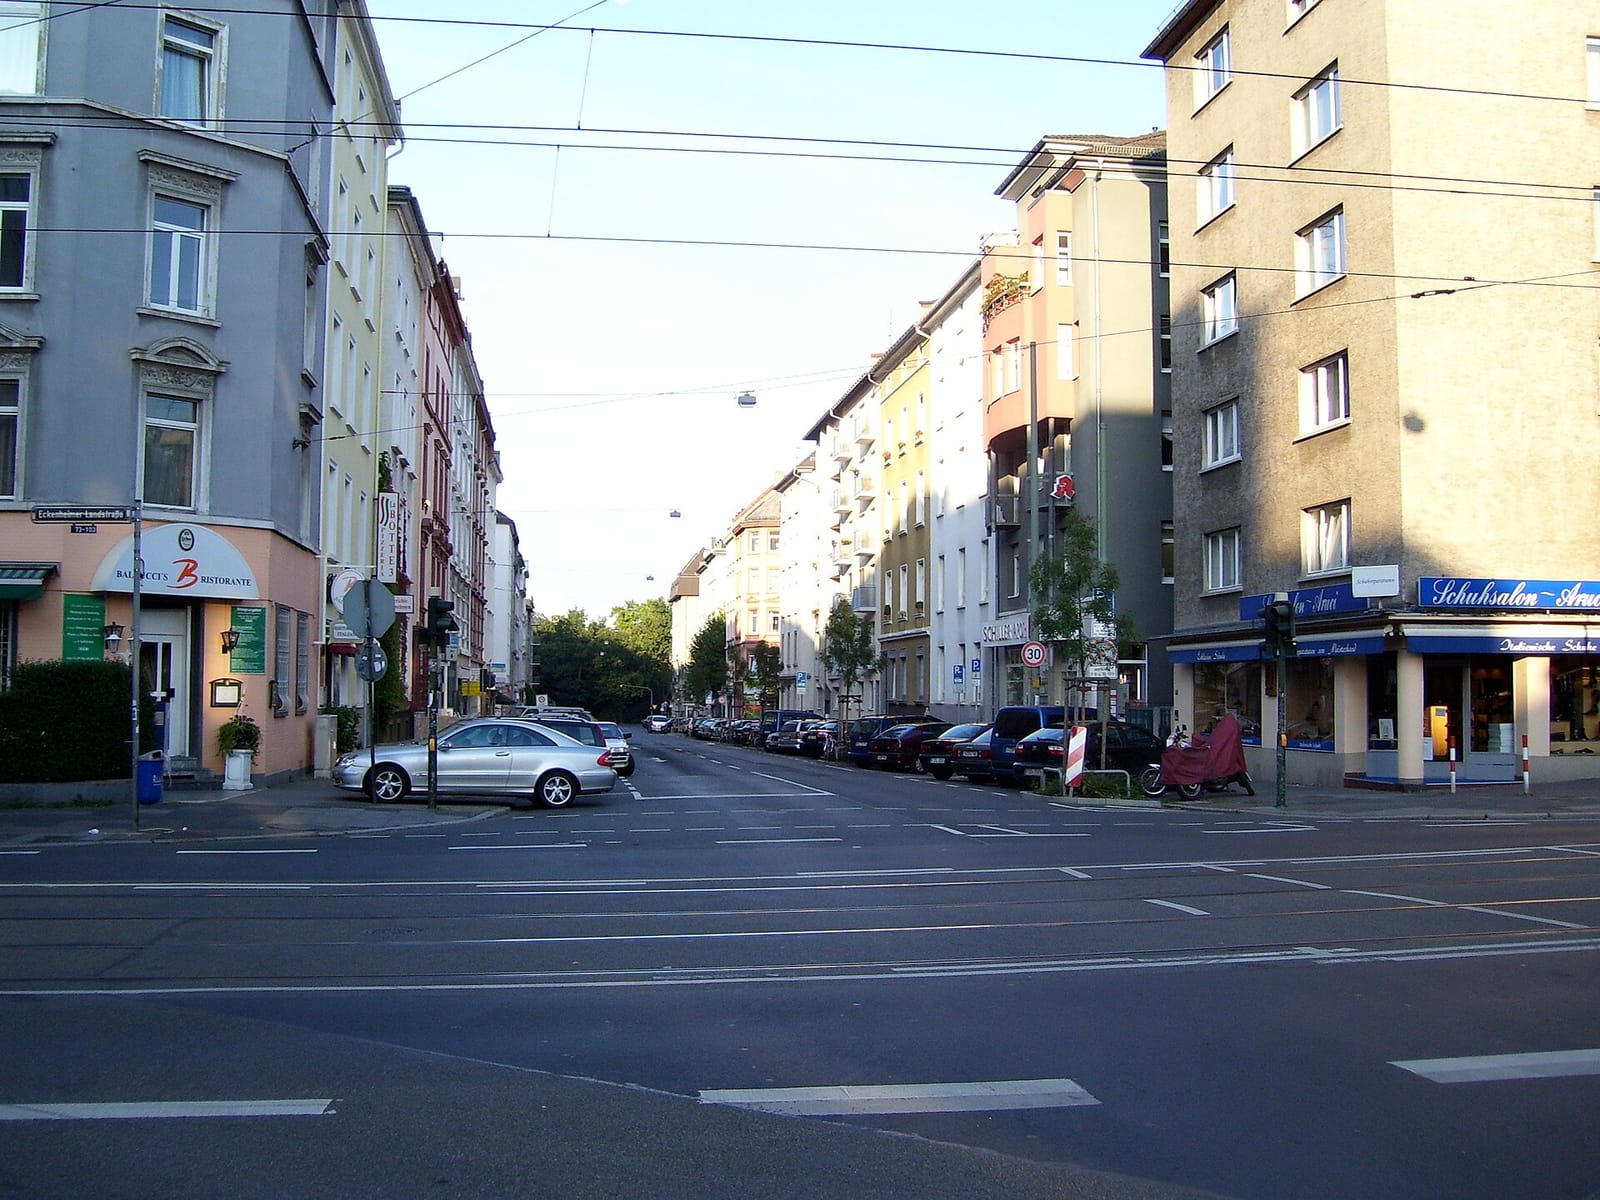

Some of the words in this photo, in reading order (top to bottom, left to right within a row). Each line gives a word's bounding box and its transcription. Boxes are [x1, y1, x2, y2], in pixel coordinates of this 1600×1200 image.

[38, 510, 83, 519] Eckenheimer
[84, 510, 124, 520] Landstraße
[116, 570, 169, 581] BALCCI'S
[201, 575, 252, 587] RISTORANTE
[1432, 578, 1539, 607] Schuhsalon
[1026, 648, 1041, 660] 30
